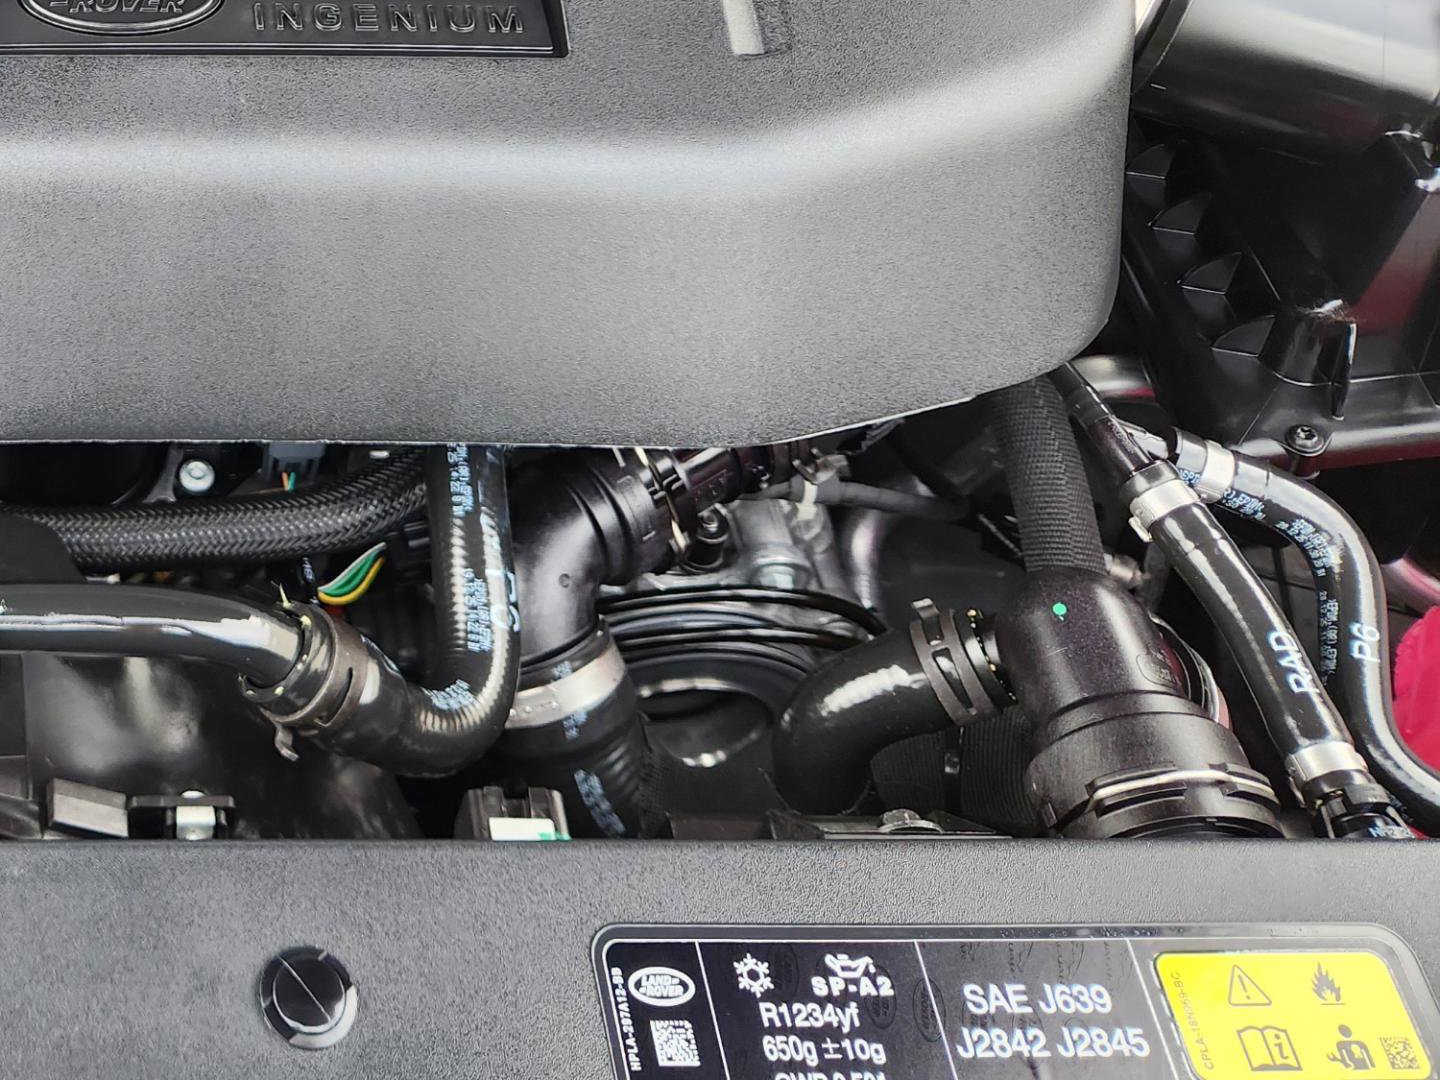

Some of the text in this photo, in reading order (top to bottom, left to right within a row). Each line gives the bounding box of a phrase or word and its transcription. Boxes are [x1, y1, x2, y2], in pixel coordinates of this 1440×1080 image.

[252, 1, 525, 34] INGENIUM
[1348, 622, 1381, 663] P6
[1267, 630, 1321, 694] RAD
[641, 974, 672, 986] LAND
[645, 985, 685, 998] ROVER
[810, 975, 895, 997] SP-A2
[962, 983, 1034, 1015] SAE
[1037, 983, 1113, 1015] J639
[760, 1001, 861, 1034] R1234yf
[762, 1034, 887, 1067] 650g ±10g
[955, 1026, 1151, 1058] J2842 J2845
